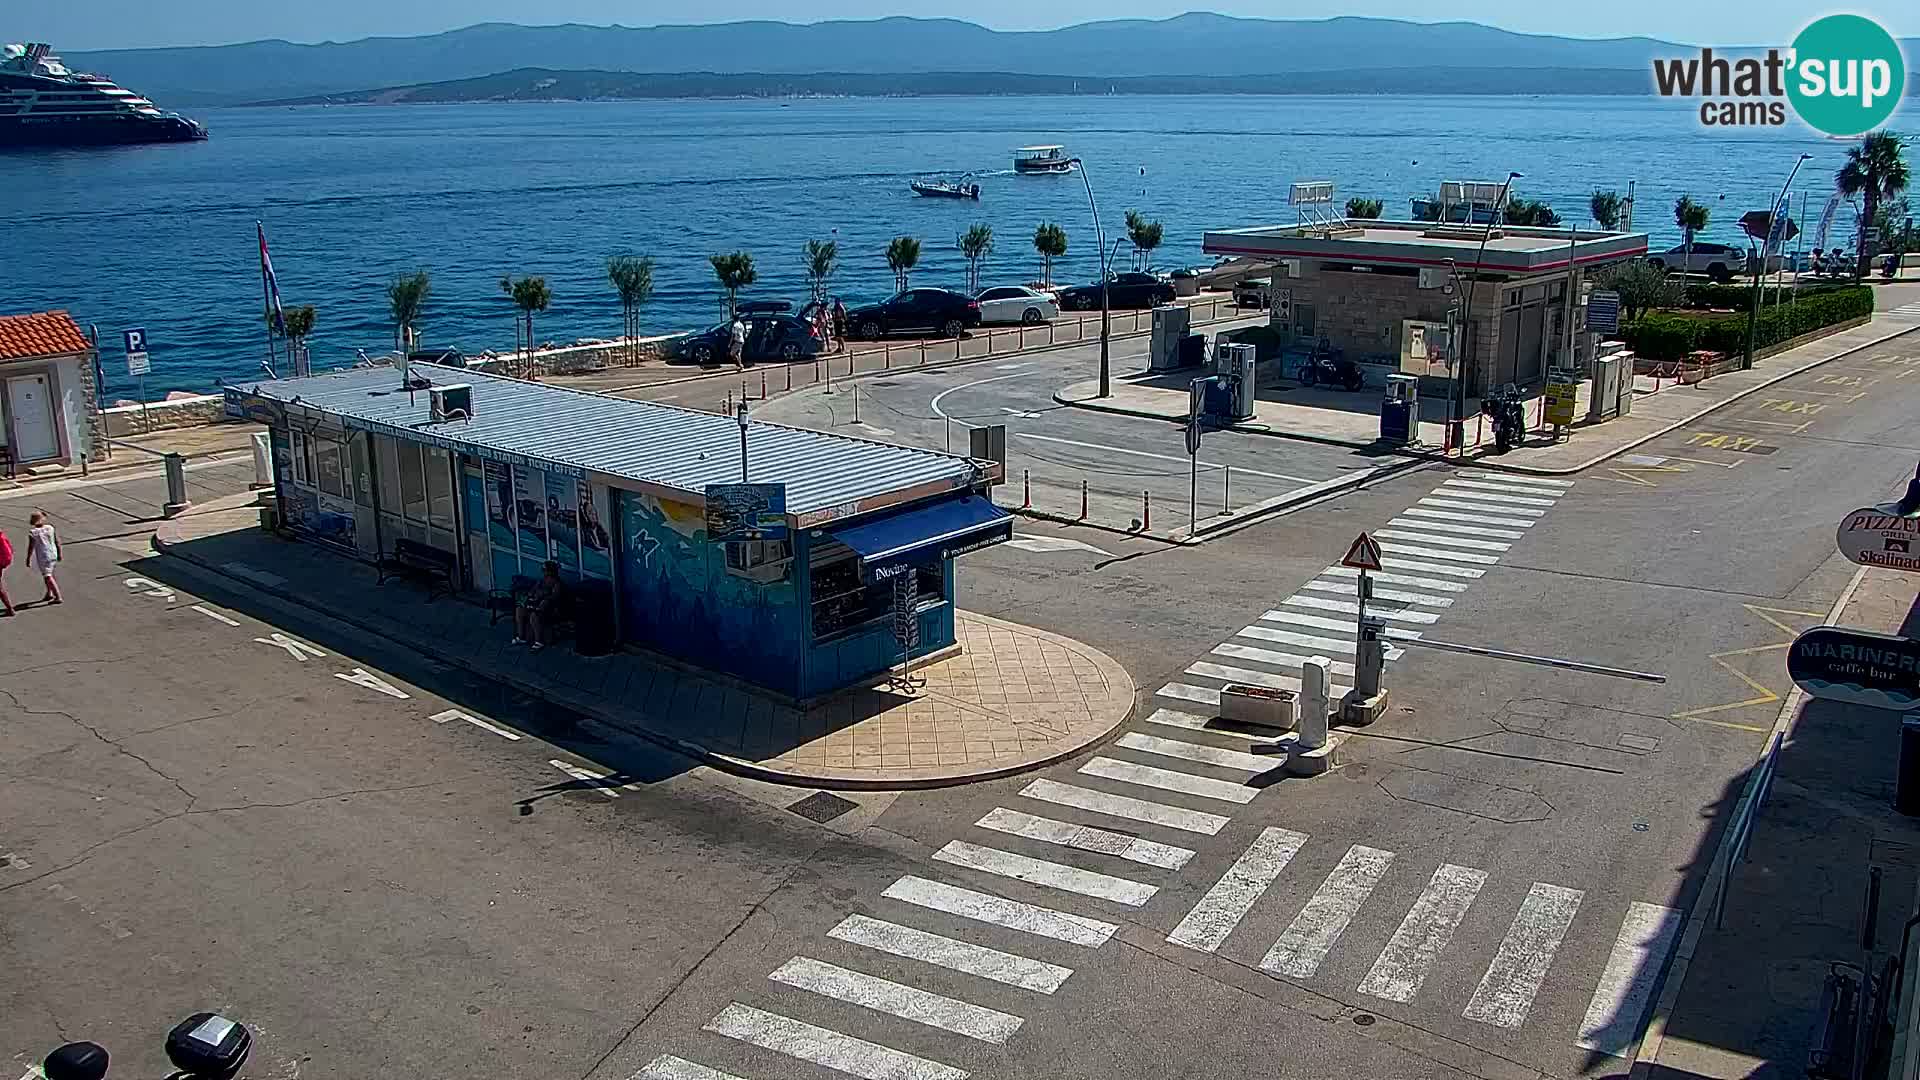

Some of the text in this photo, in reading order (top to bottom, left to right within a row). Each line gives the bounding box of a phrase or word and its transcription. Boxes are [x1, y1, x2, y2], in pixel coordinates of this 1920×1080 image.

[128, 332, 141, 350] P
[1685, 433, 1764, 452] TAXI
[494, 451, 525, 465] STATION
[528, 458, 553, 472] TICKET
[555, 463, 582, 478] OFFICE
[1848, 514, 1920, 534] PIZZE
[1801, 642, 1920, 673] MARINER
[1870, 665, 1897, 680] bar
